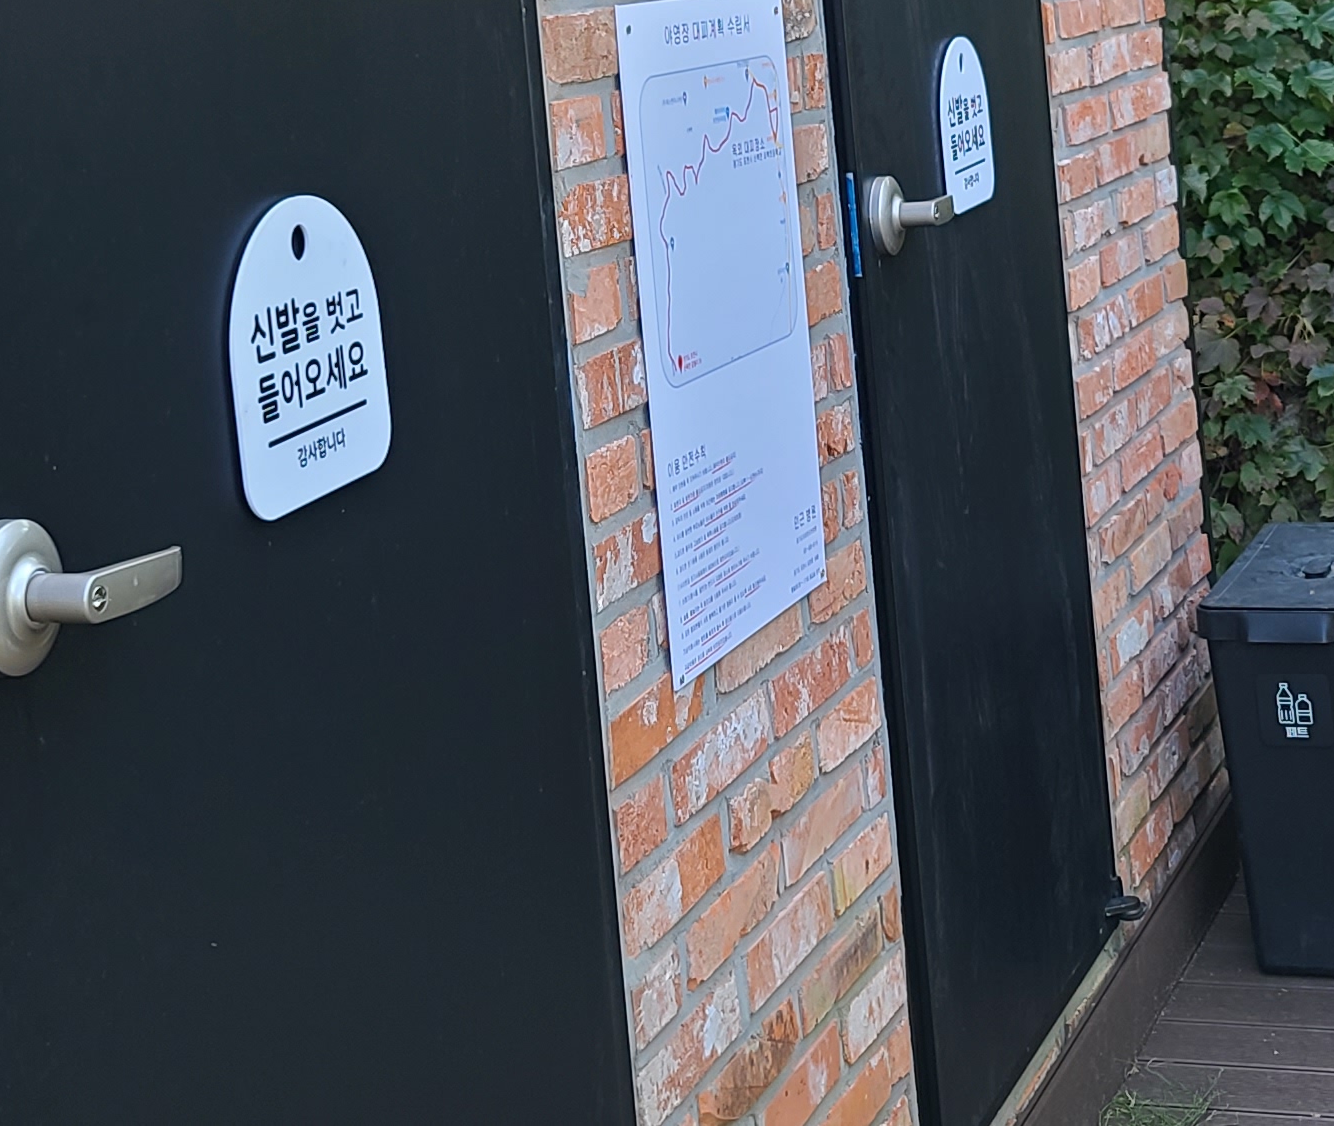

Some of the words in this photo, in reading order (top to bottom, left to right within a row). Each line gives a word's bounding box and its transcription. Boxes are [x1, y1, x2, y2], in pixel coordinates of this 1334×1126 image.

[664, 23, 689, 46] 야영장
[692, 18, 724, 41] 대피계획
[727, 14, 750, 36] 수립서
[947, 94, 970, 128] 신발을
[970, 94, 984, 118] 벗고
[950, 124, 986, 161] 들어오세요
[250, 297, 320, 364] 신발을
[326, 288, 364, 334] 벗고
[257, 341, 369, 424] 들어오세요
[297, 427, 346, 468] 감사합니다
